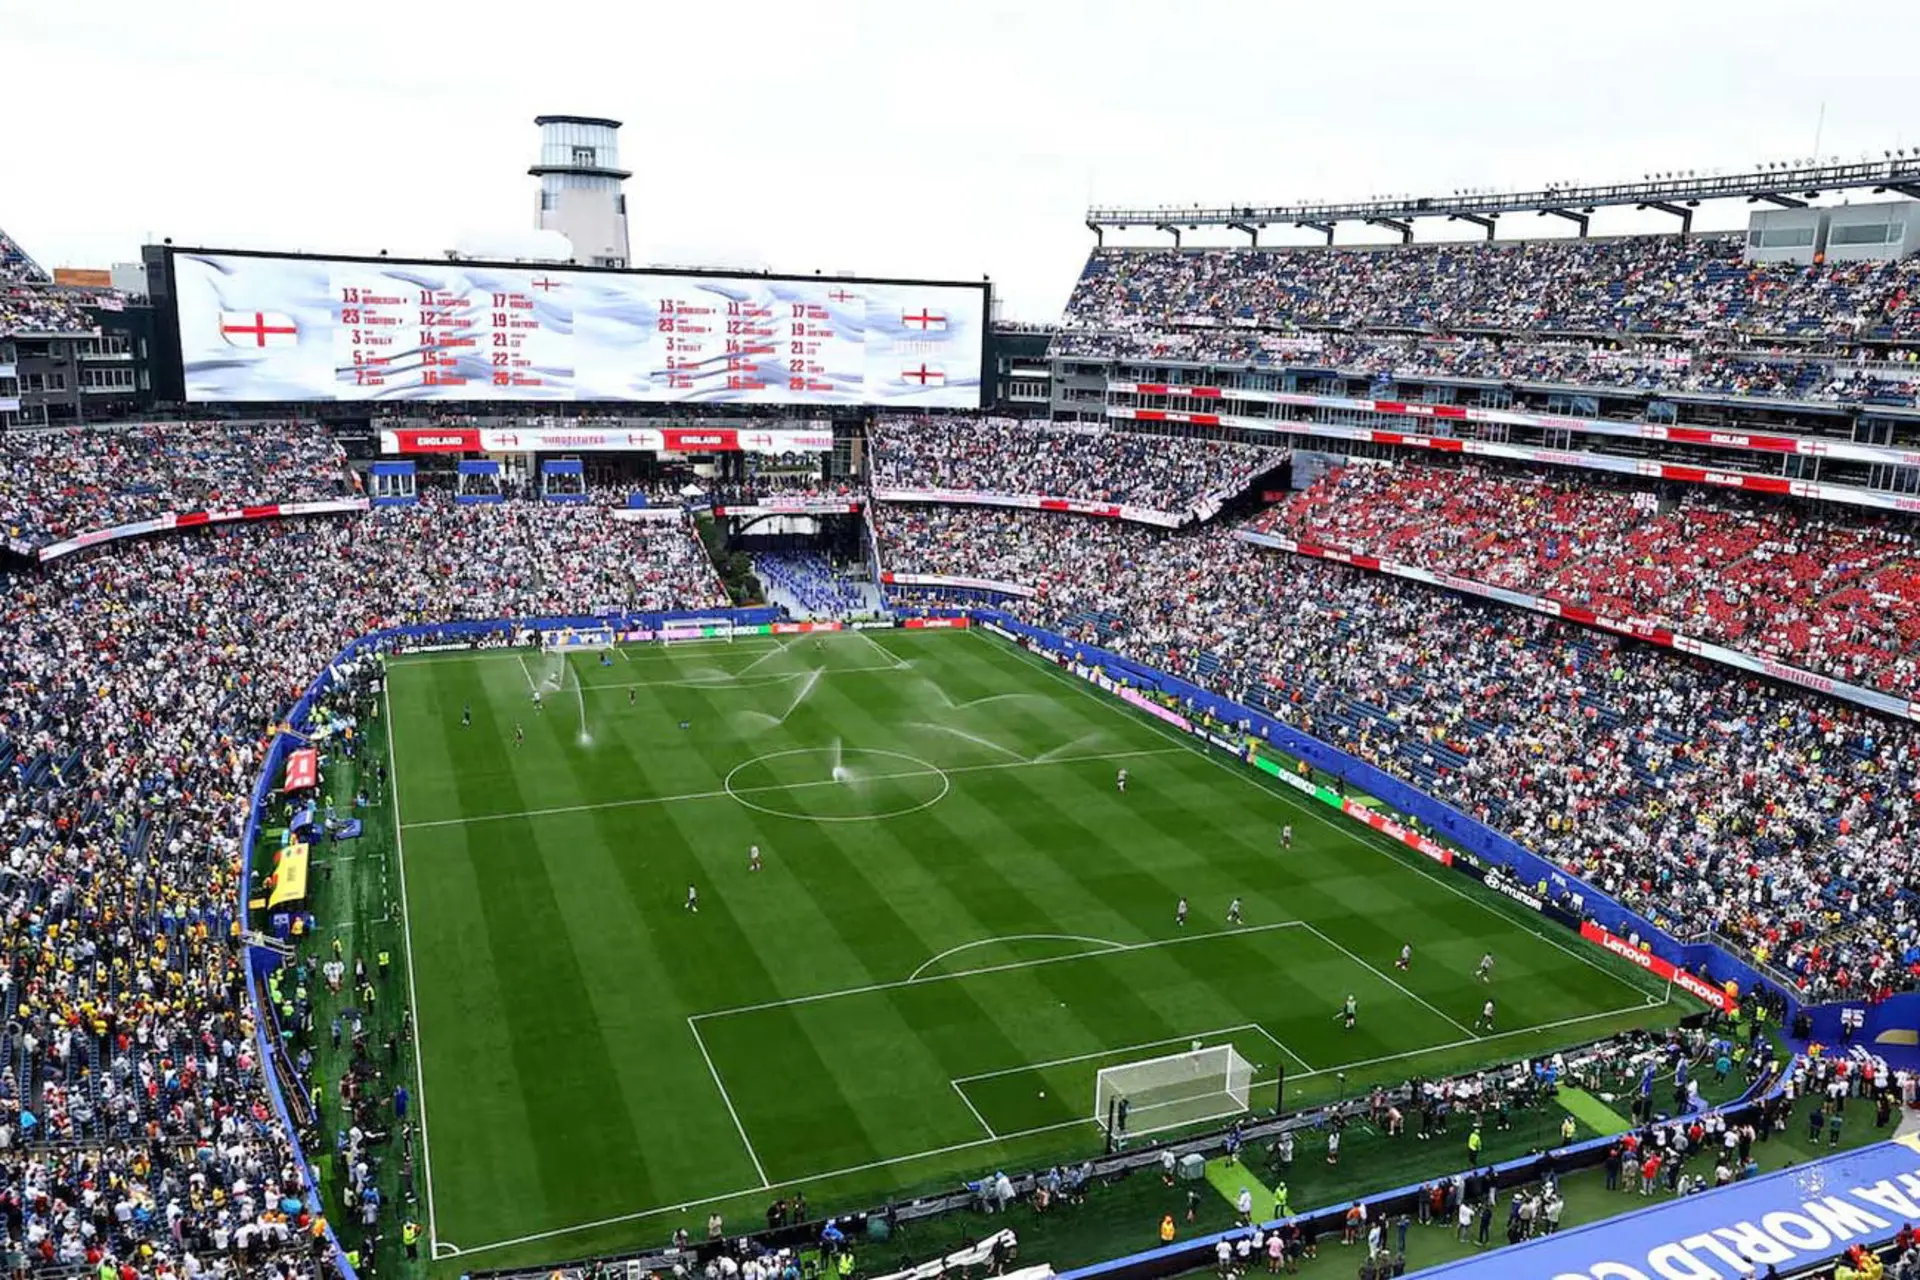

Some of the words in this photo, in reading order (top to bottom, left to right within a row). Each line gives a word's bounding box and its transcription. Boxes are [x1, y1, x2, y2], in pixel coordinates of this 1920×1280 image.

[343, 288, 358, 303] 13
[420, 290, 433, 305] 11
[493, 293, 505, 308] 17
[660, 299, 674, 313] 13
[728, 302, 740, 315] 11
[793, 304, 804, 318] 17
[342, 309, 359, 324] 23
[420, 311, 435, 325] 12
[493, 313, 506, 327] 19
[659, 319, 674, 331] 23
[727, 321, 740, 334] 12
[792, 323, 804, 336] 19
[352, 329, 360, 344] 3
[420, 331, 435, 345] 14
[493, 332, 507, 346] 21
[667, 337, 674, 350] 3
[727, 339, 739, 353] 14
[791, 341, 804, 354] 21
[353, 350, 361, 365] 5
[422, 351, 437, 365] 15
[493, 352, 508, 366] 22
[790, 360, 804, 373] 22
[355, 371, 363, 385] 7
[417, 436, 462, 445] ENGLAND
[1603, 933, 1651, 967] Lenovo
[1673, 969, 1725, 1007] Lenovo
[1648, 1196, 1892, 1280] WORLD
